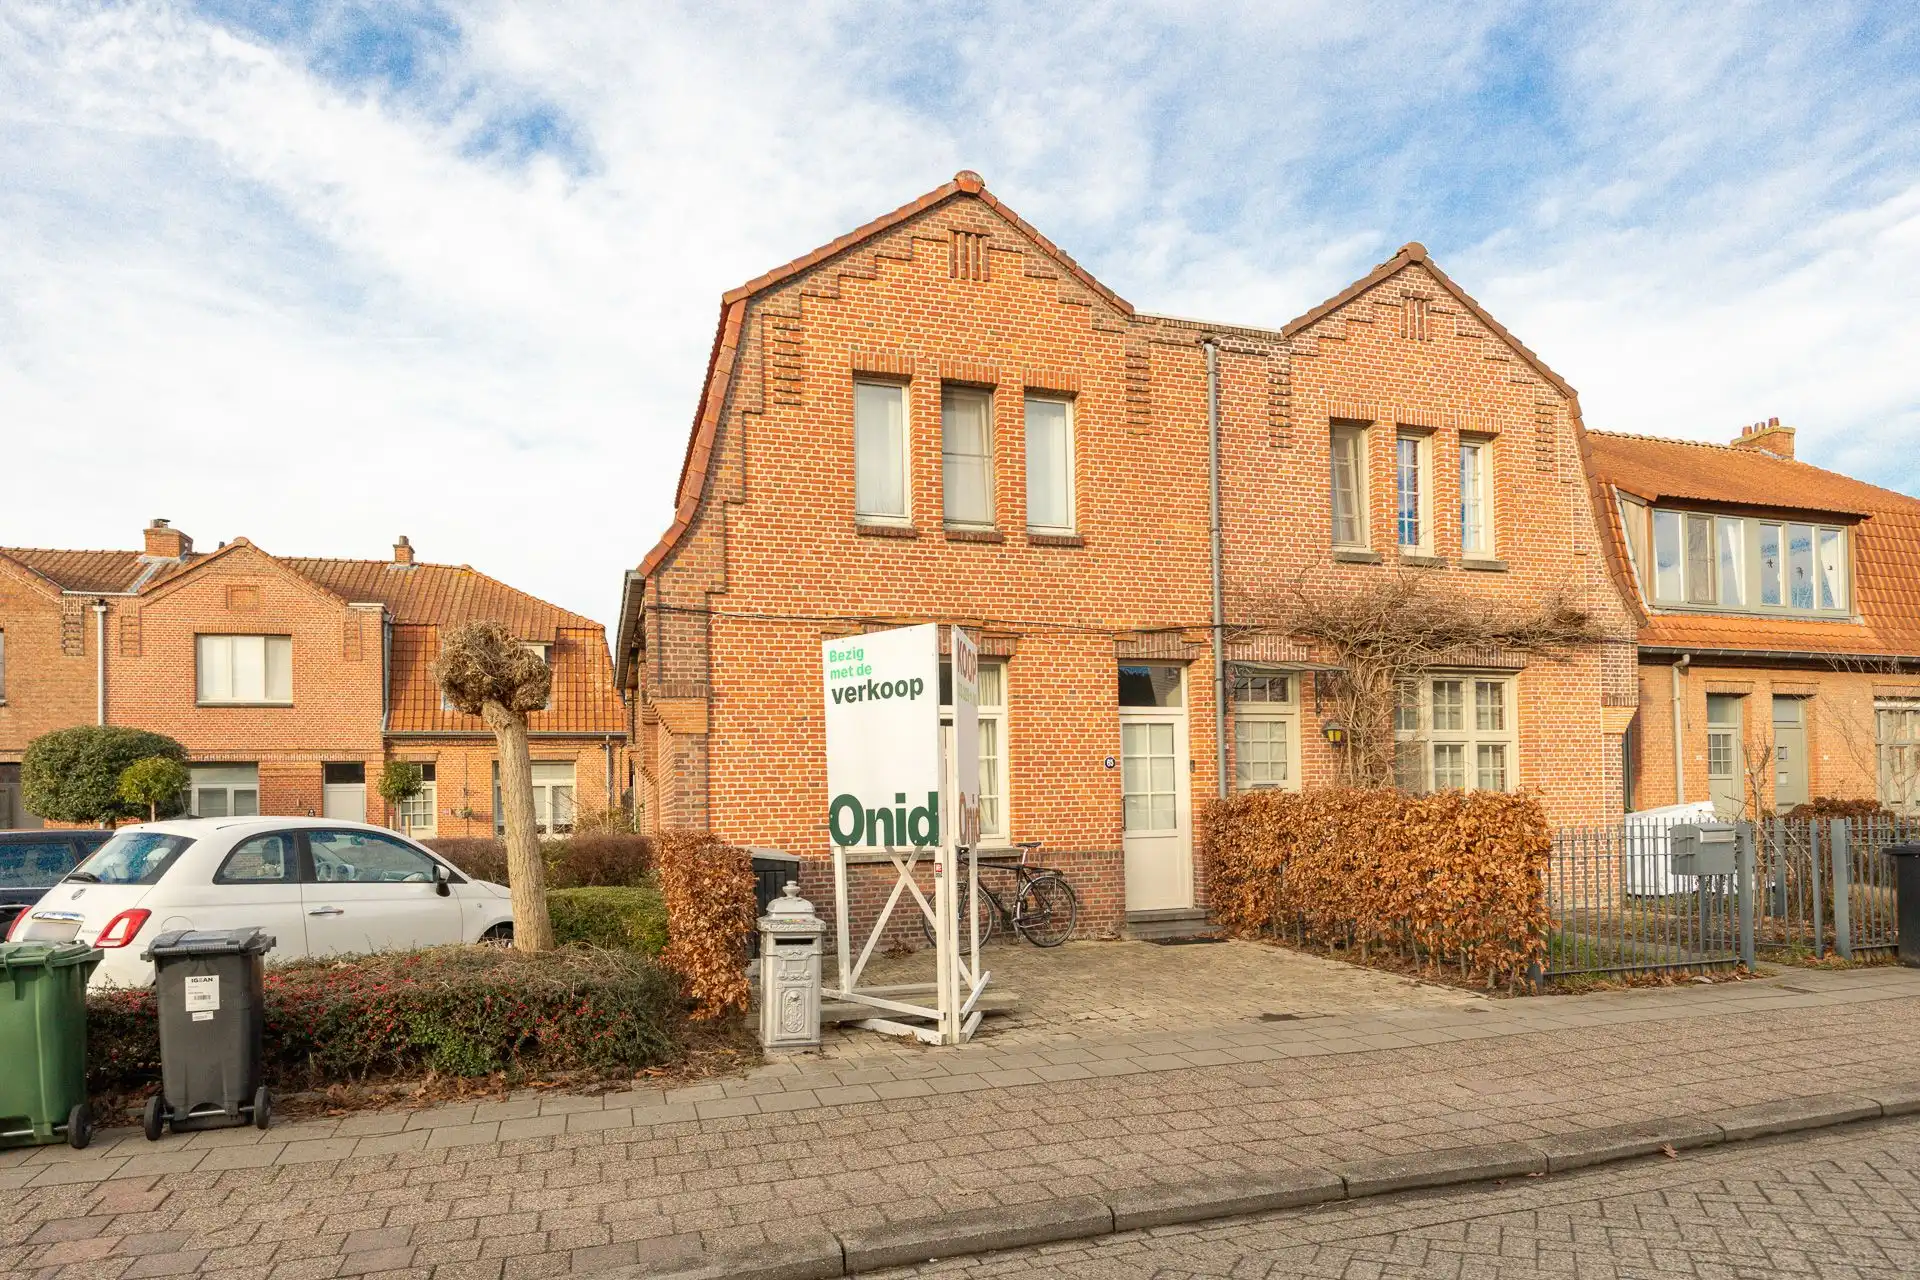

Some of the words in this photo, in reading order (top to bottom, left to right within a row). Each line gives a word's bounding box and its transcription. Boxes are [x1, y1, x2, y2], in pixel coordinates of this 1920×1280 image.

[829, 646, 864, 662] Bezig
[957, 638, 977, 684] KOOP
[830, 666, 853, 680] met
[856, 663, 872, 676] de
[831, 677, 924, 704] verkoop
[829, 791, 939, 847] Onid
